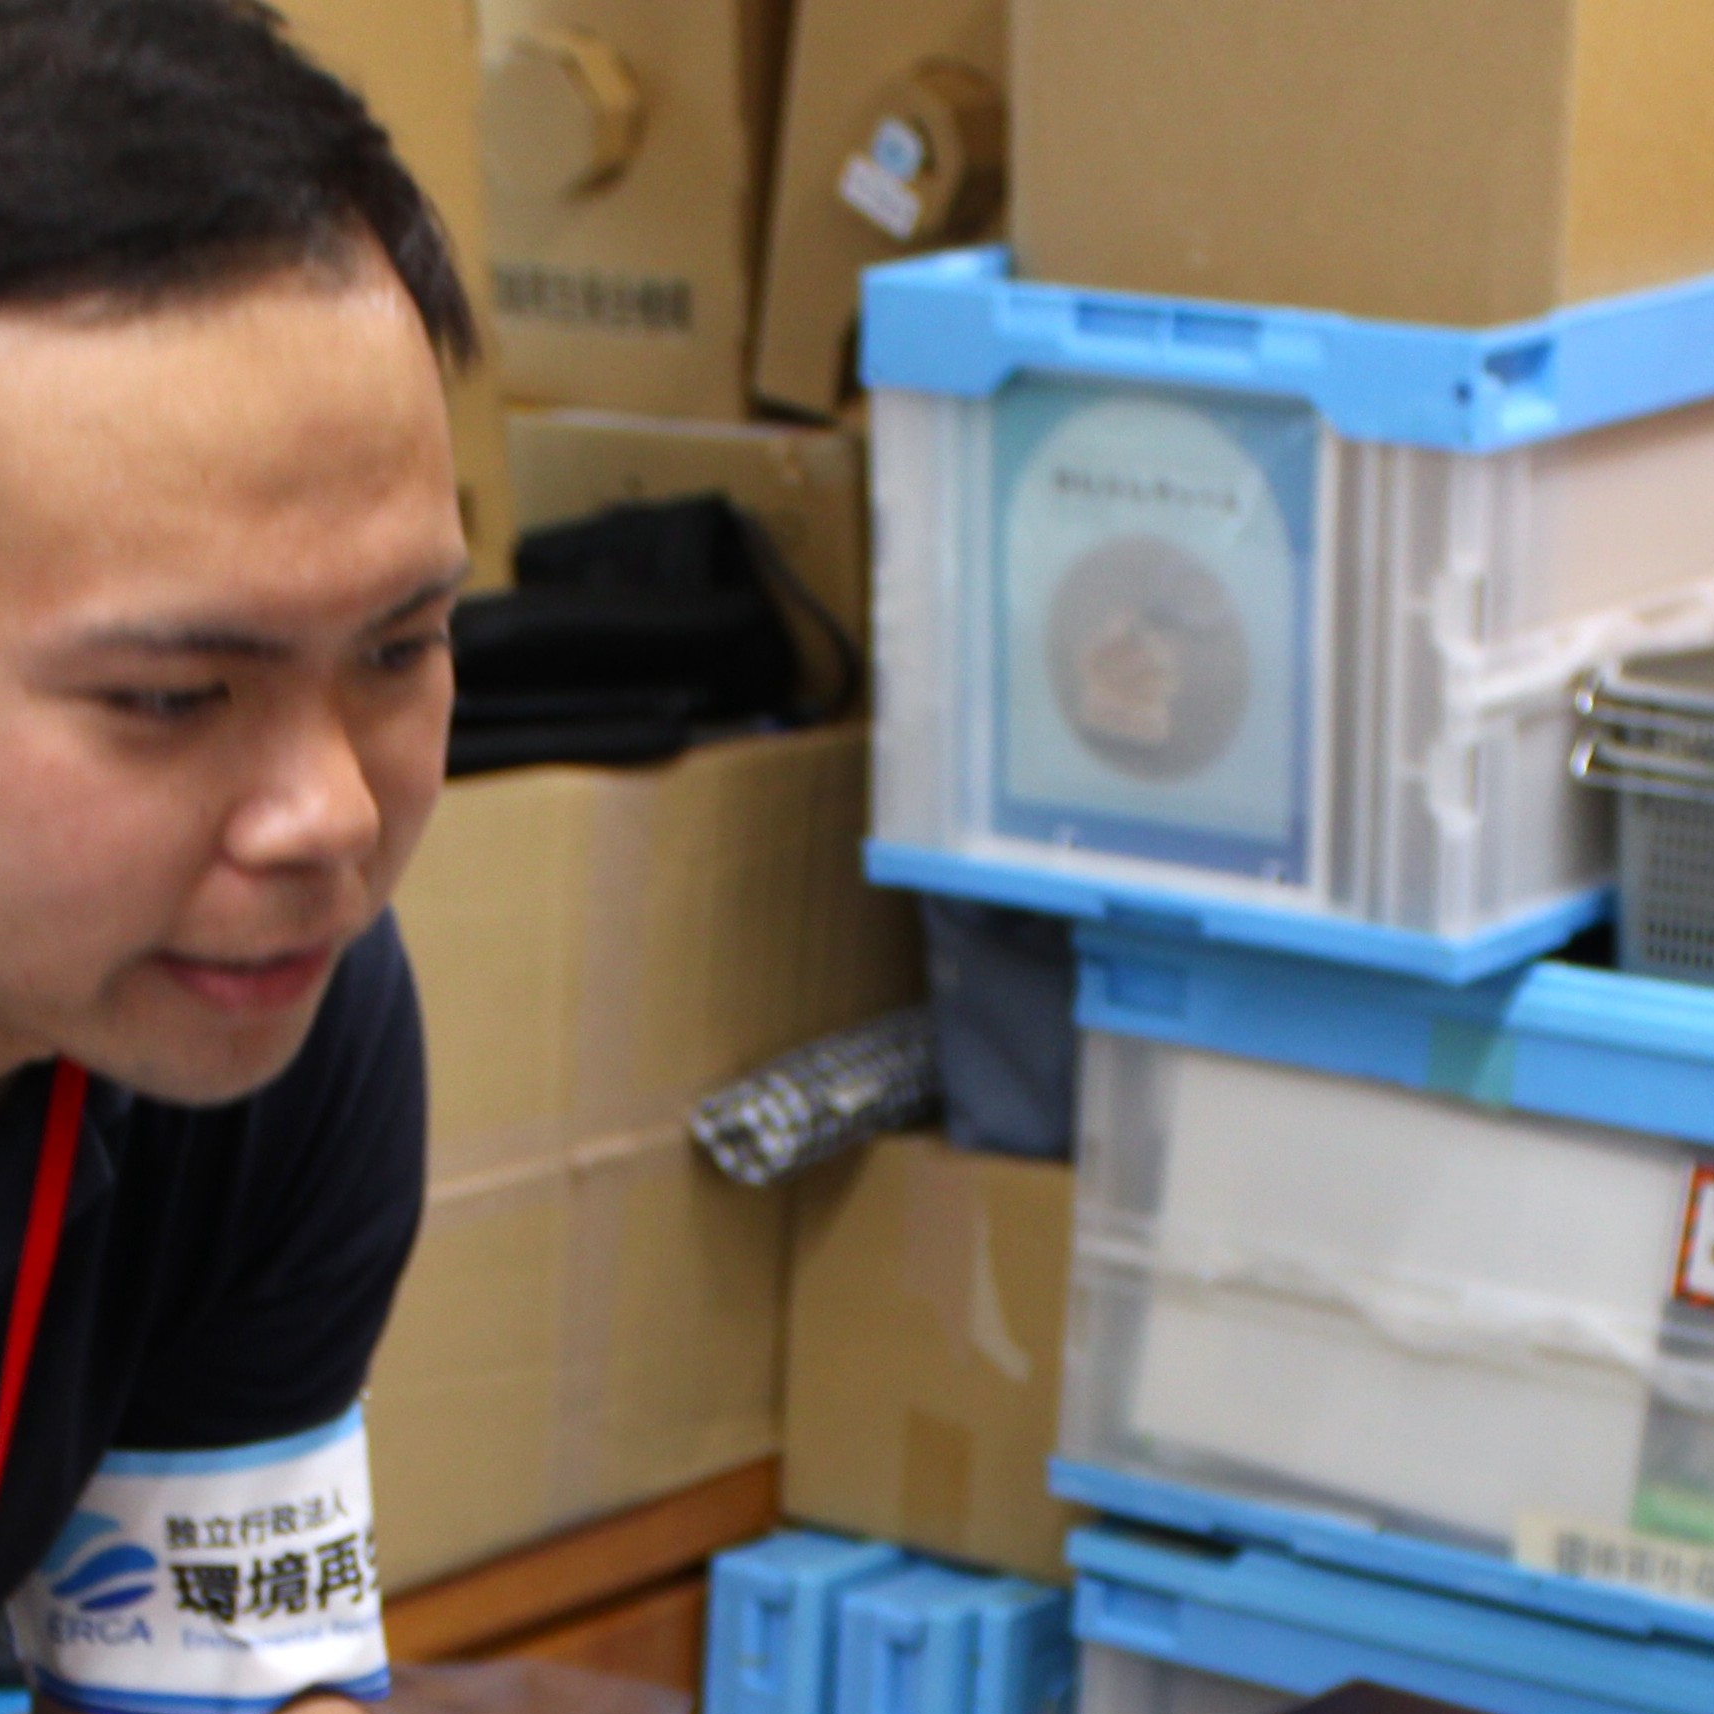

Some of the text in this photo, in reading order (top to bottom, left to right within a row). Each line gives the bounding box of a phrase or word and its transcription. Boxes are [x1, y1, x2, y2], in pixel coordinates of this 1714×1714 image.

[166, 1487, 349, 1549] 独立行政法人
